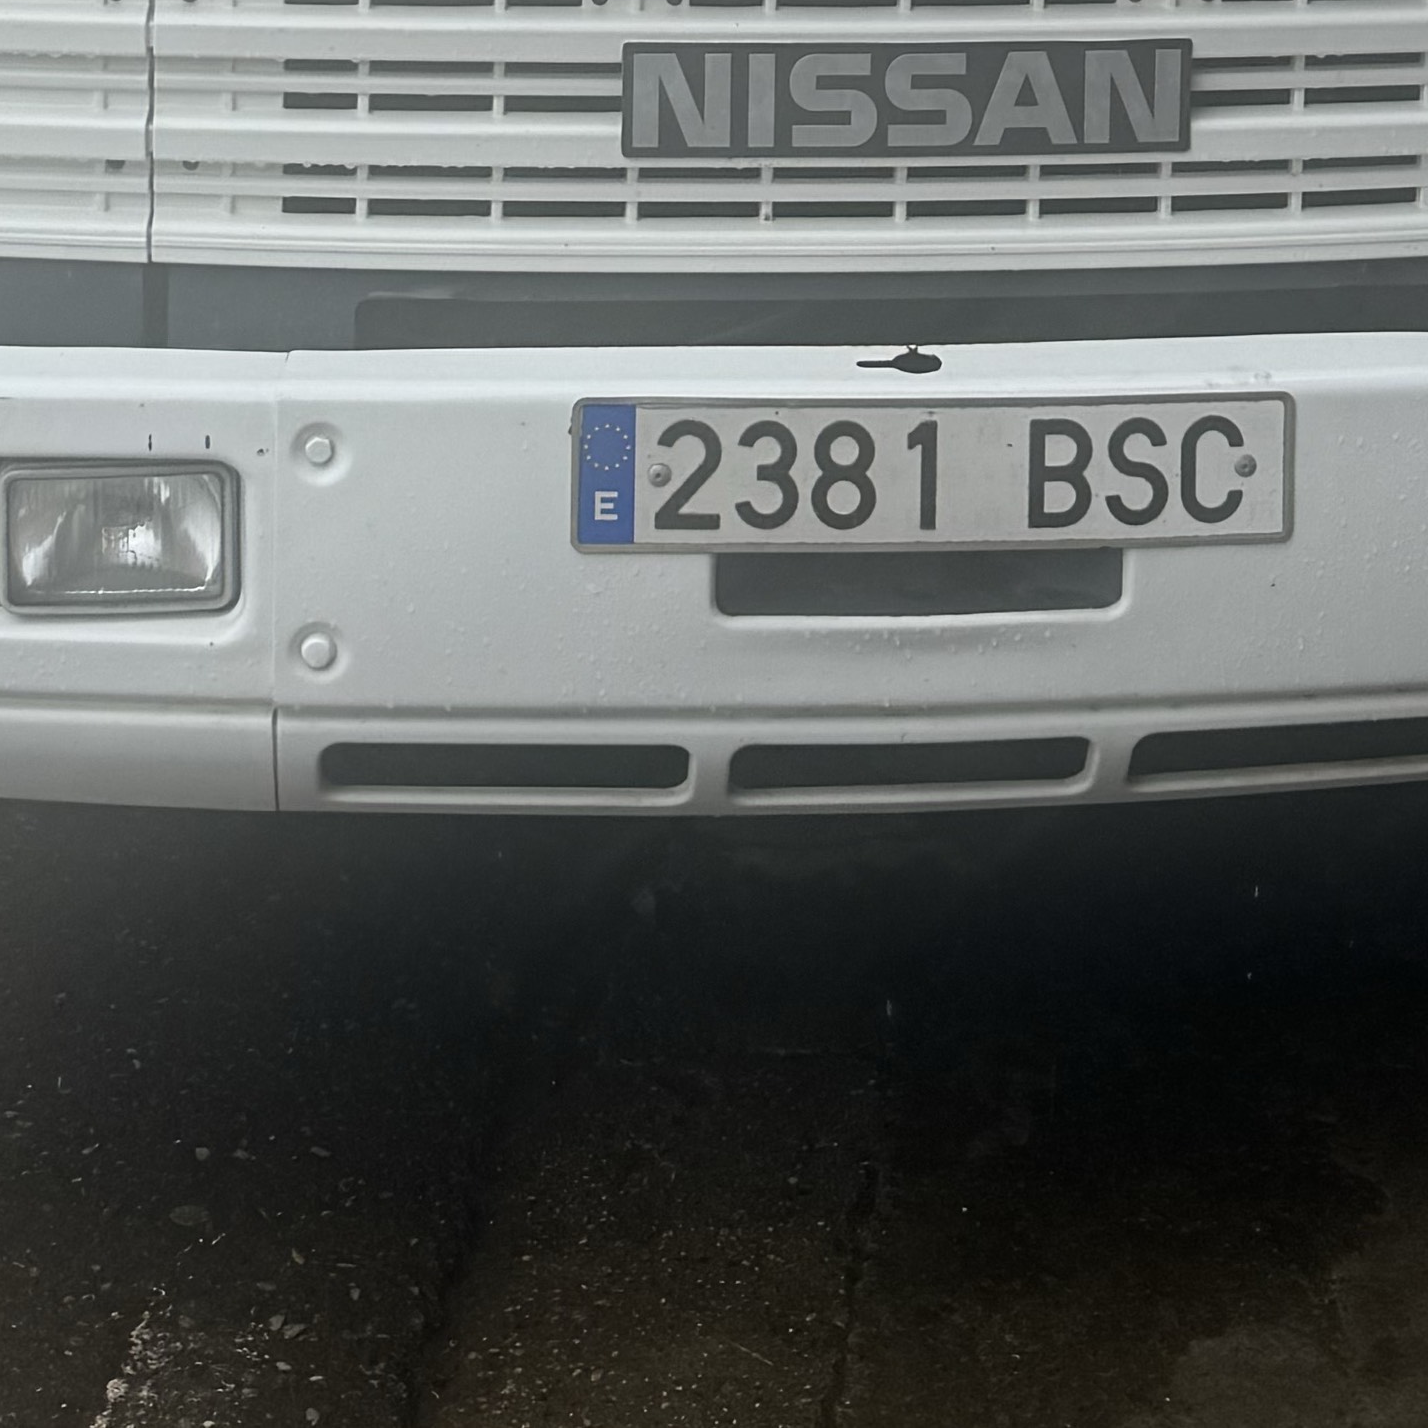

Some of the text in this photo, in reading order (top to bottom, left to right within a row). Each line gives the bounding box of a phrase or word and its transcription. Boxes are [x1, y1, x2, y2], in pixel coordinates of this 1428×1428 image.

[630, 48, 1182, 148] NISSAN
[593, 415, 1245, 531] E 2381 BSC
